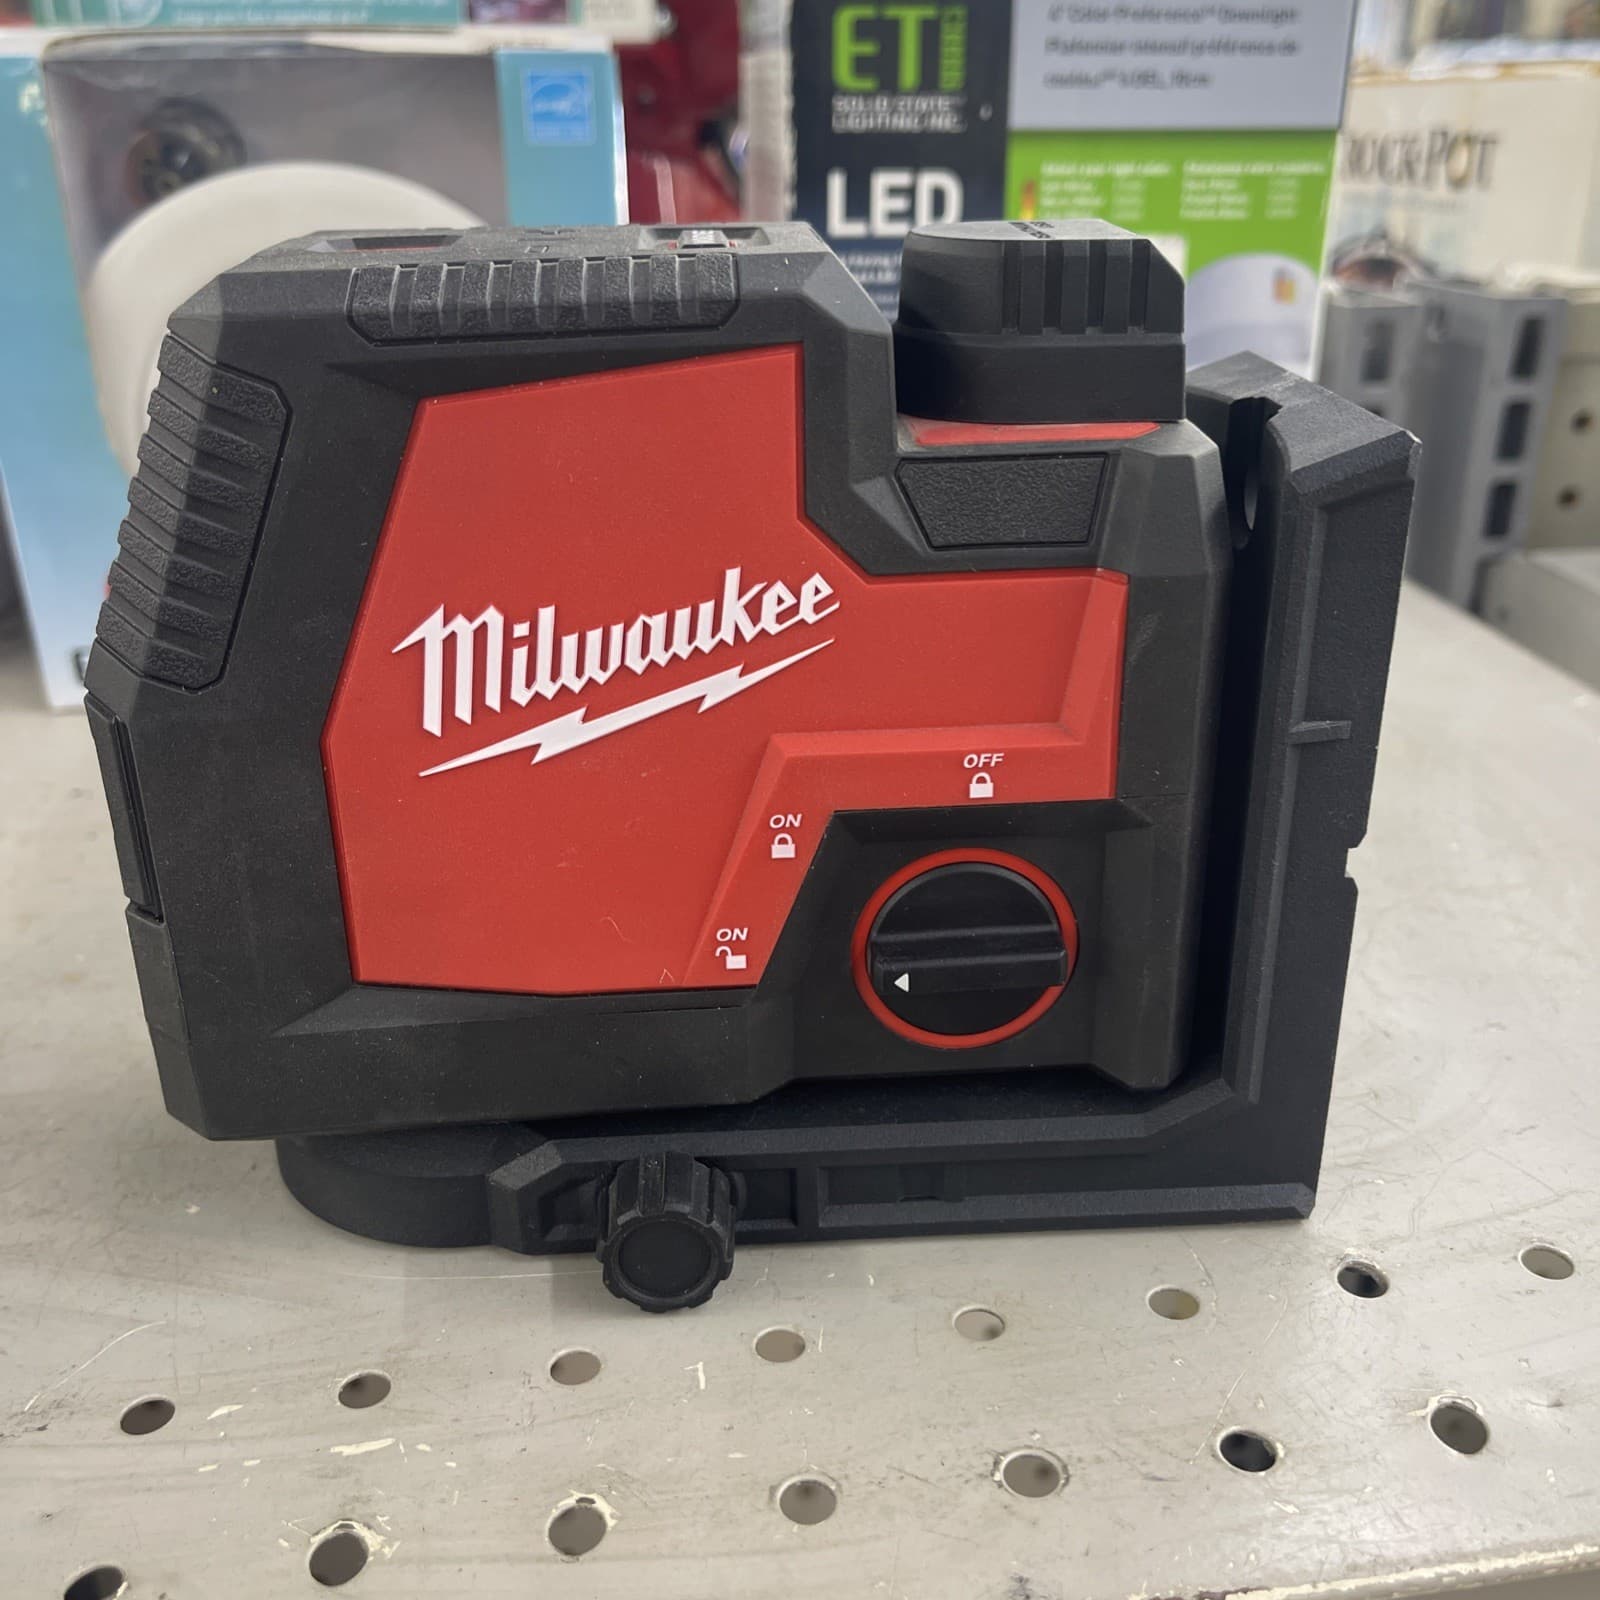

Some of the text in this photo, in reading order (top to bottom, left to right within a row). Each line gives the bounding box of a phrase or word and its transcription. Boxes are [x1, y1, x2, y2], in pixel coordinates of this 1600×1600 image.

[826, 168, 964, 239] LED
[392, 566, 841, 738] Milwaukee
[963, 753, 1004, 768] OFF
[769, 814, 802, 828] ON
[716, 928, 748, 941] ON
